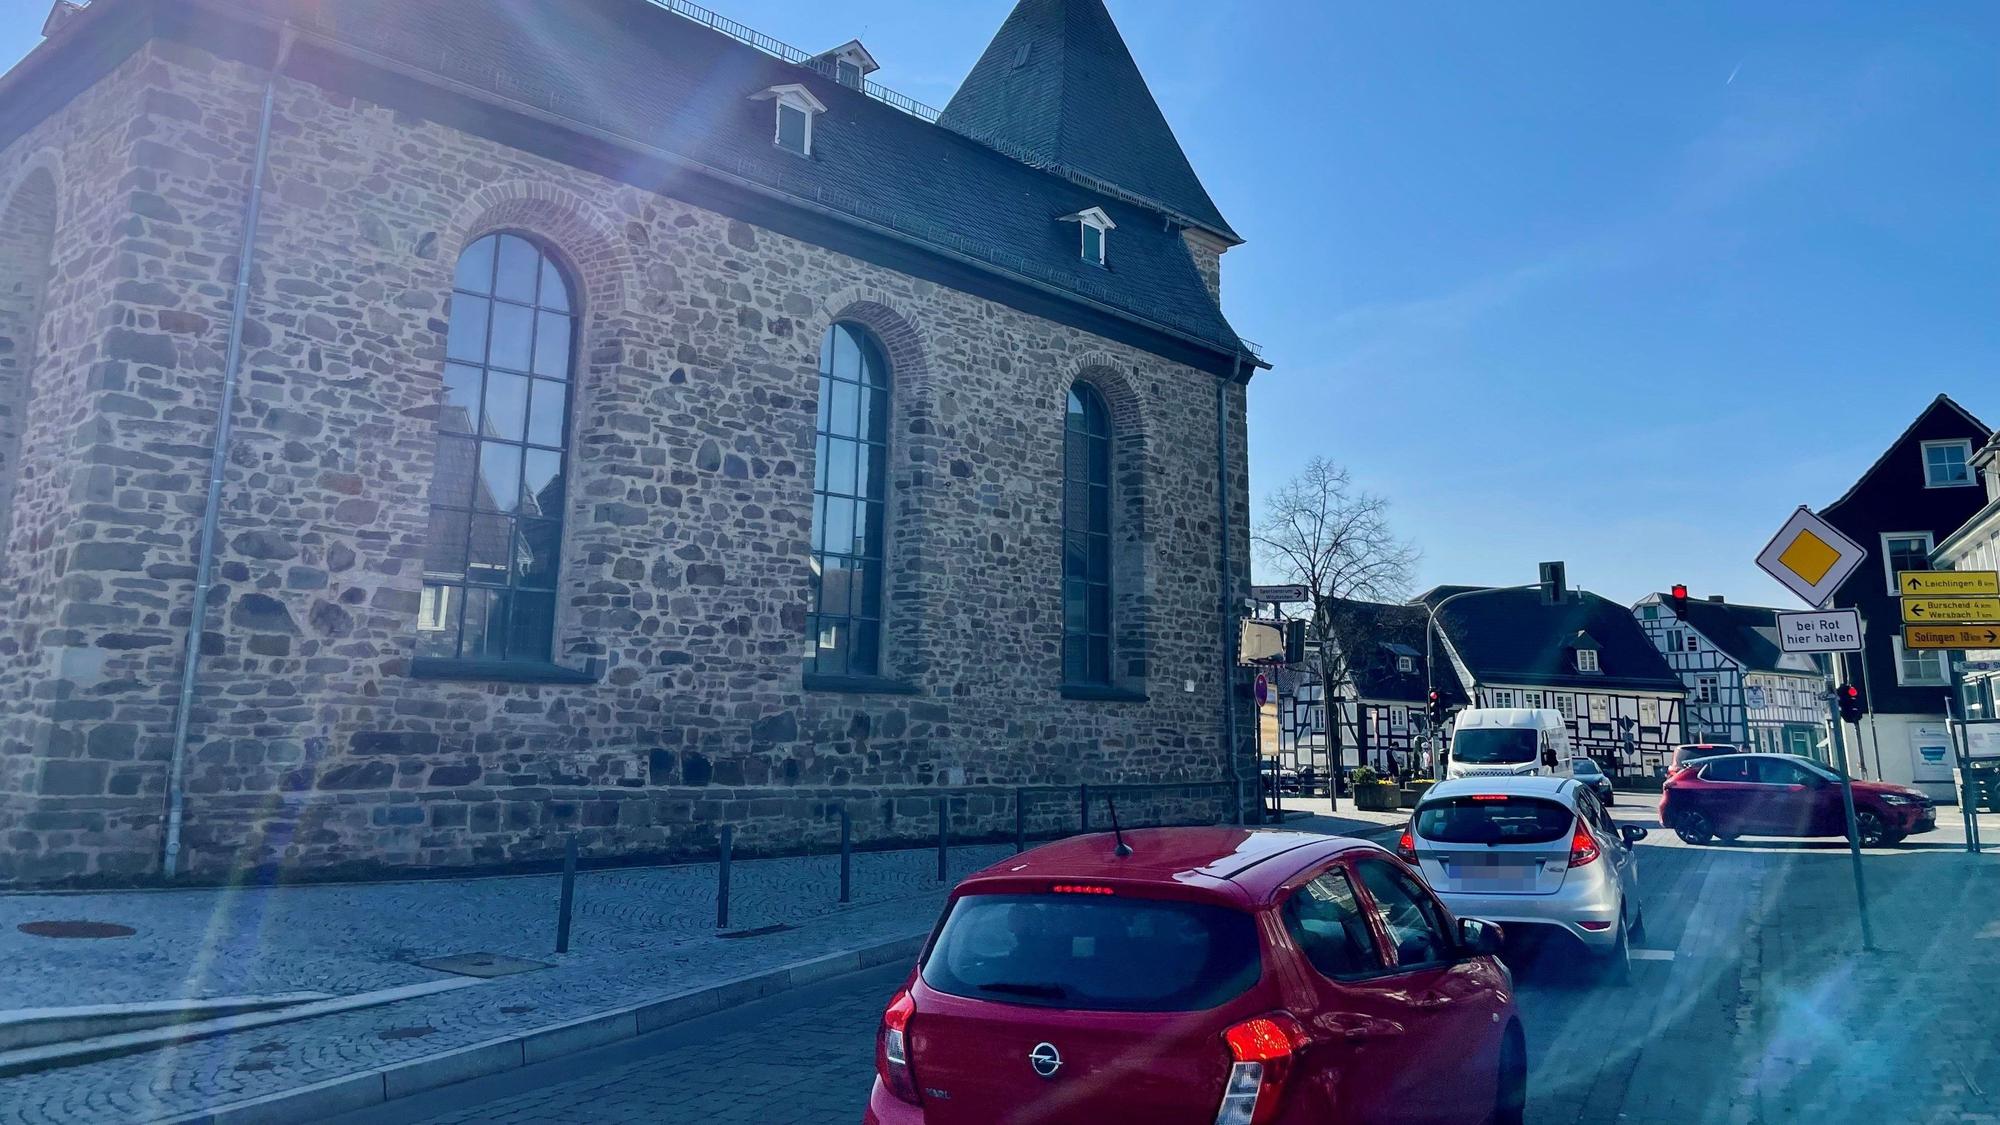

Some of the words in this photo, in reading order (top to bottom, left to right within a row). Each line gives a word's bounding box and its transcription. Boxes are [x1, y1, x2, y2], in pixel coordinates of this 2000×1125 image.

[1927, 601, 1970, 609] Burscheid
[1796, 620, 1815, 631] bei
[1819, 620, 1840, 630] Rot
[1787, 633, 1811, 644] hier
[1815, 632, 1854, 643] halten
[1914, 632, 1955, 644] Solingen
